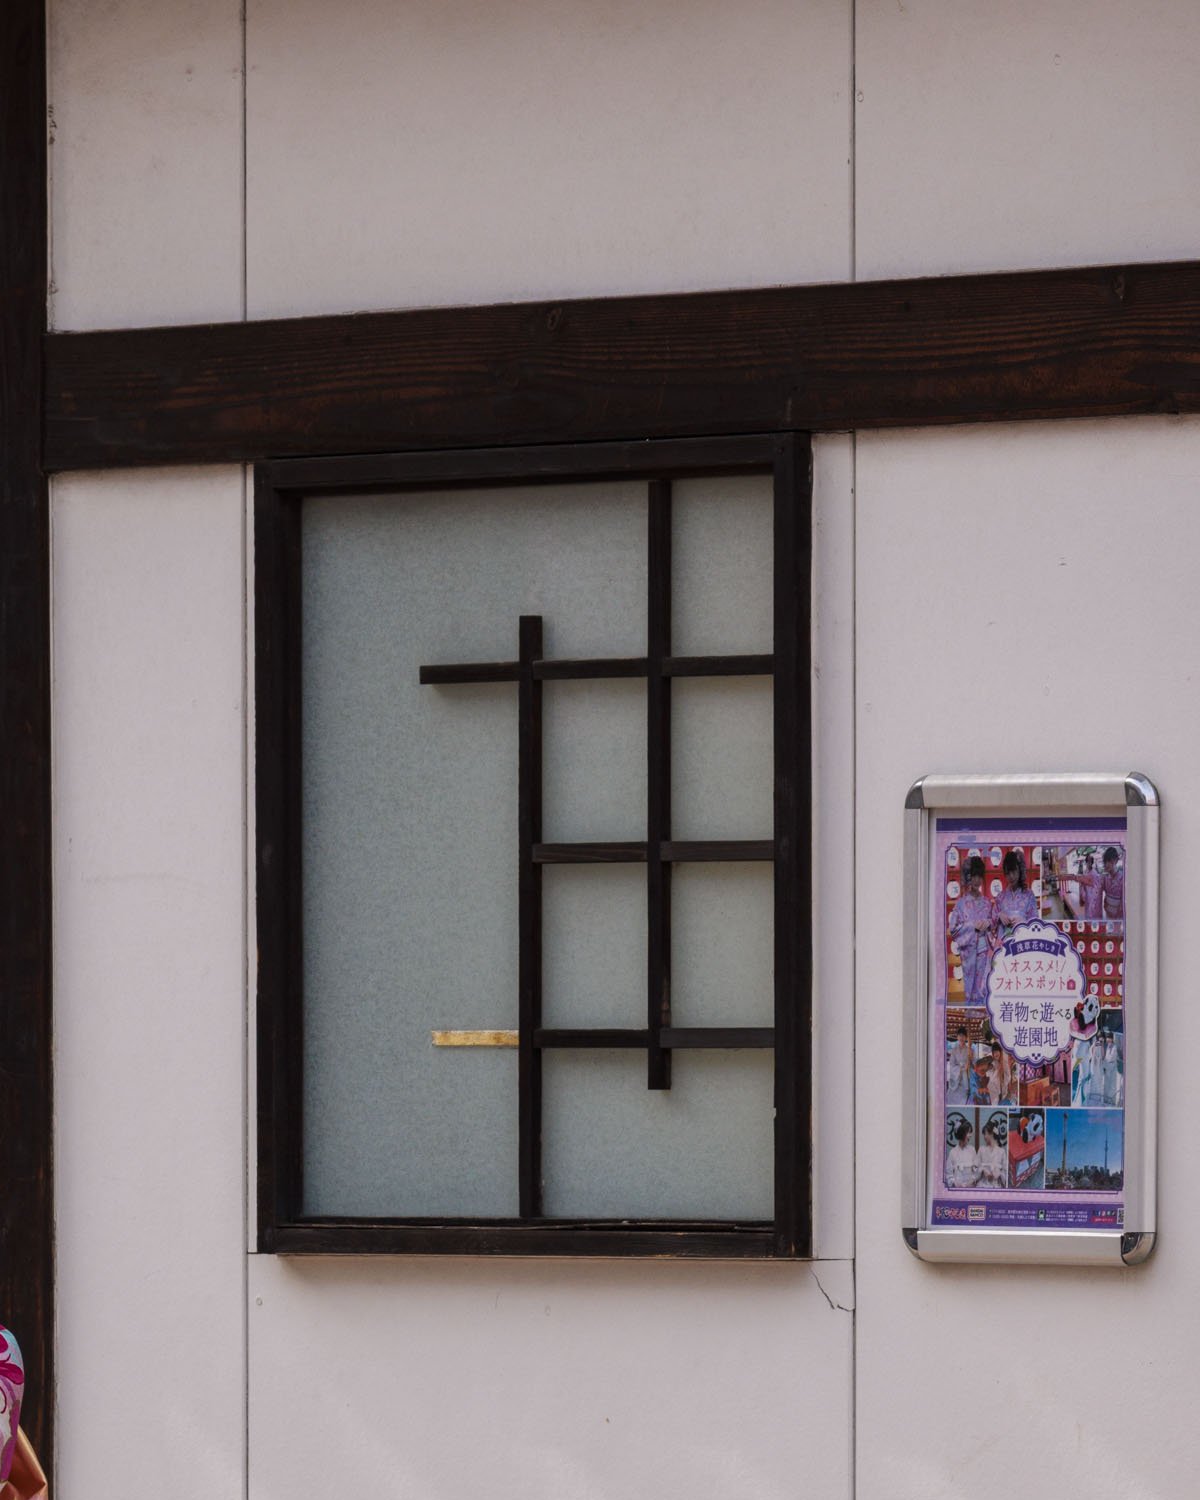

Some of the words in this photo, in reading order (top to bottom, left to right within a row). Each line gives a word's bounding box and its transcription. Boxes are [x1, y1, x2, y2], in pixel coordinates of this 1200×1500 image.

[996, 975, 1066, 991] フォトスポット
[1000, 1001, 1072, 1023] 着物で遊べる
[1014, 1026, 1059, 1047] 遊園地
